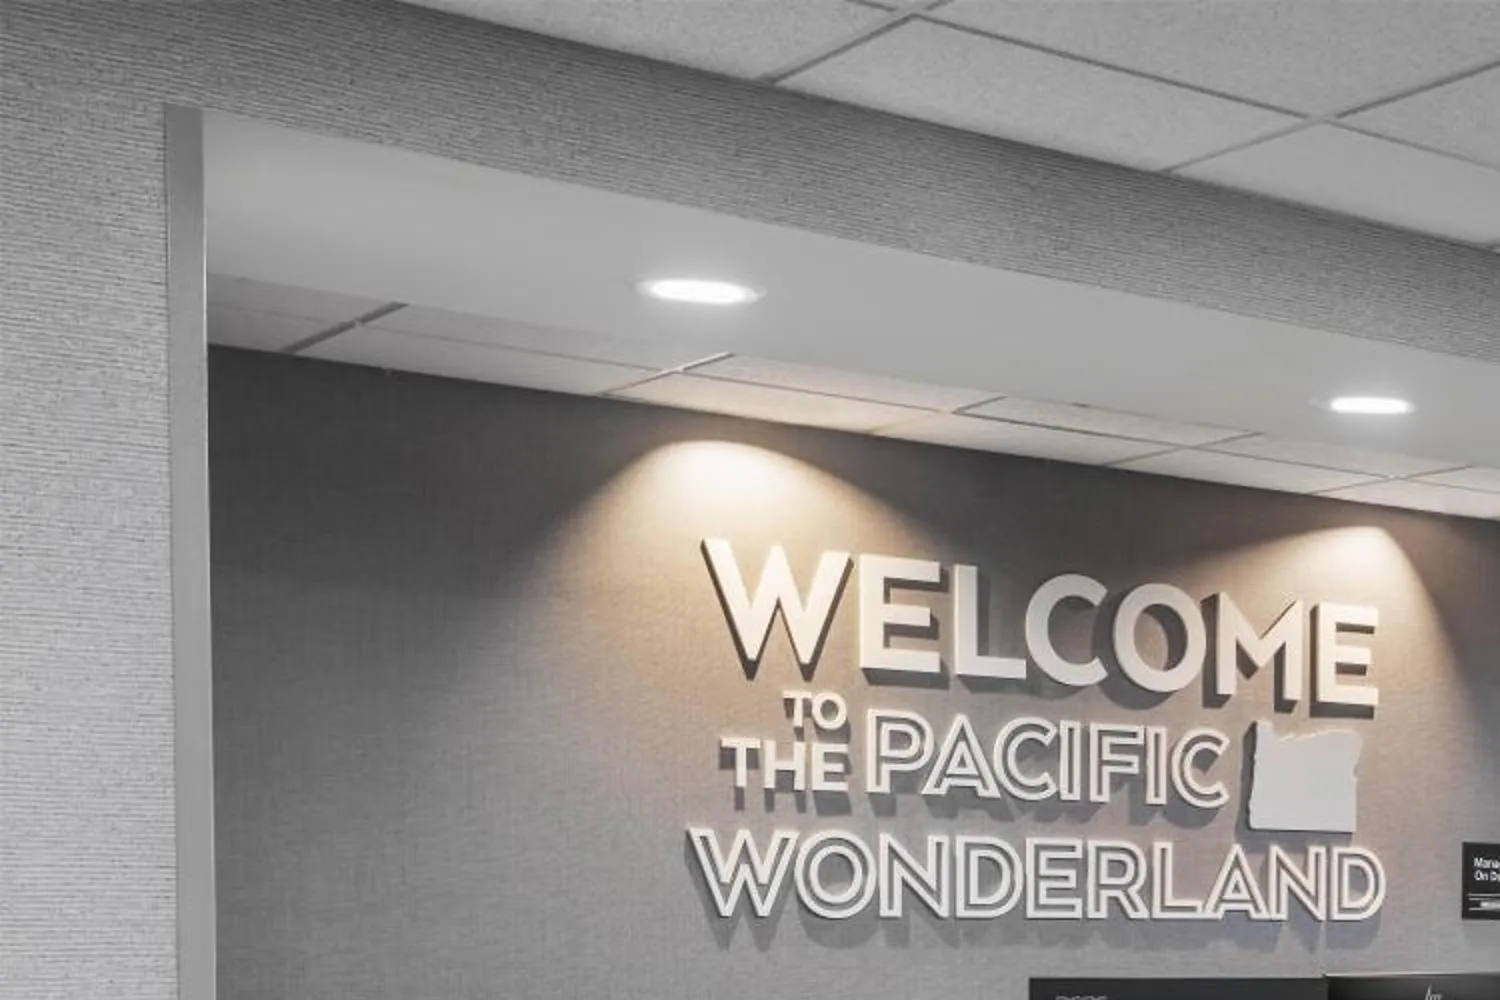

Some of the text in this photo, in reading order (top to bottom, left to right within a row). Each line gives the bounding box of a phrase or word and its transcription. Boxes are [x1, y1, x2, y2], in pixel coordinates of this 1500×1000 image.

[700, 538, 1380, 707] WELCOME
[720, 708, 1230, 807] THE PACIFIC
[783, 689, 848, 731] TO
[688, 827, 1387, 922] WONDERLAND
[1474, 870, 1489, 881] On
